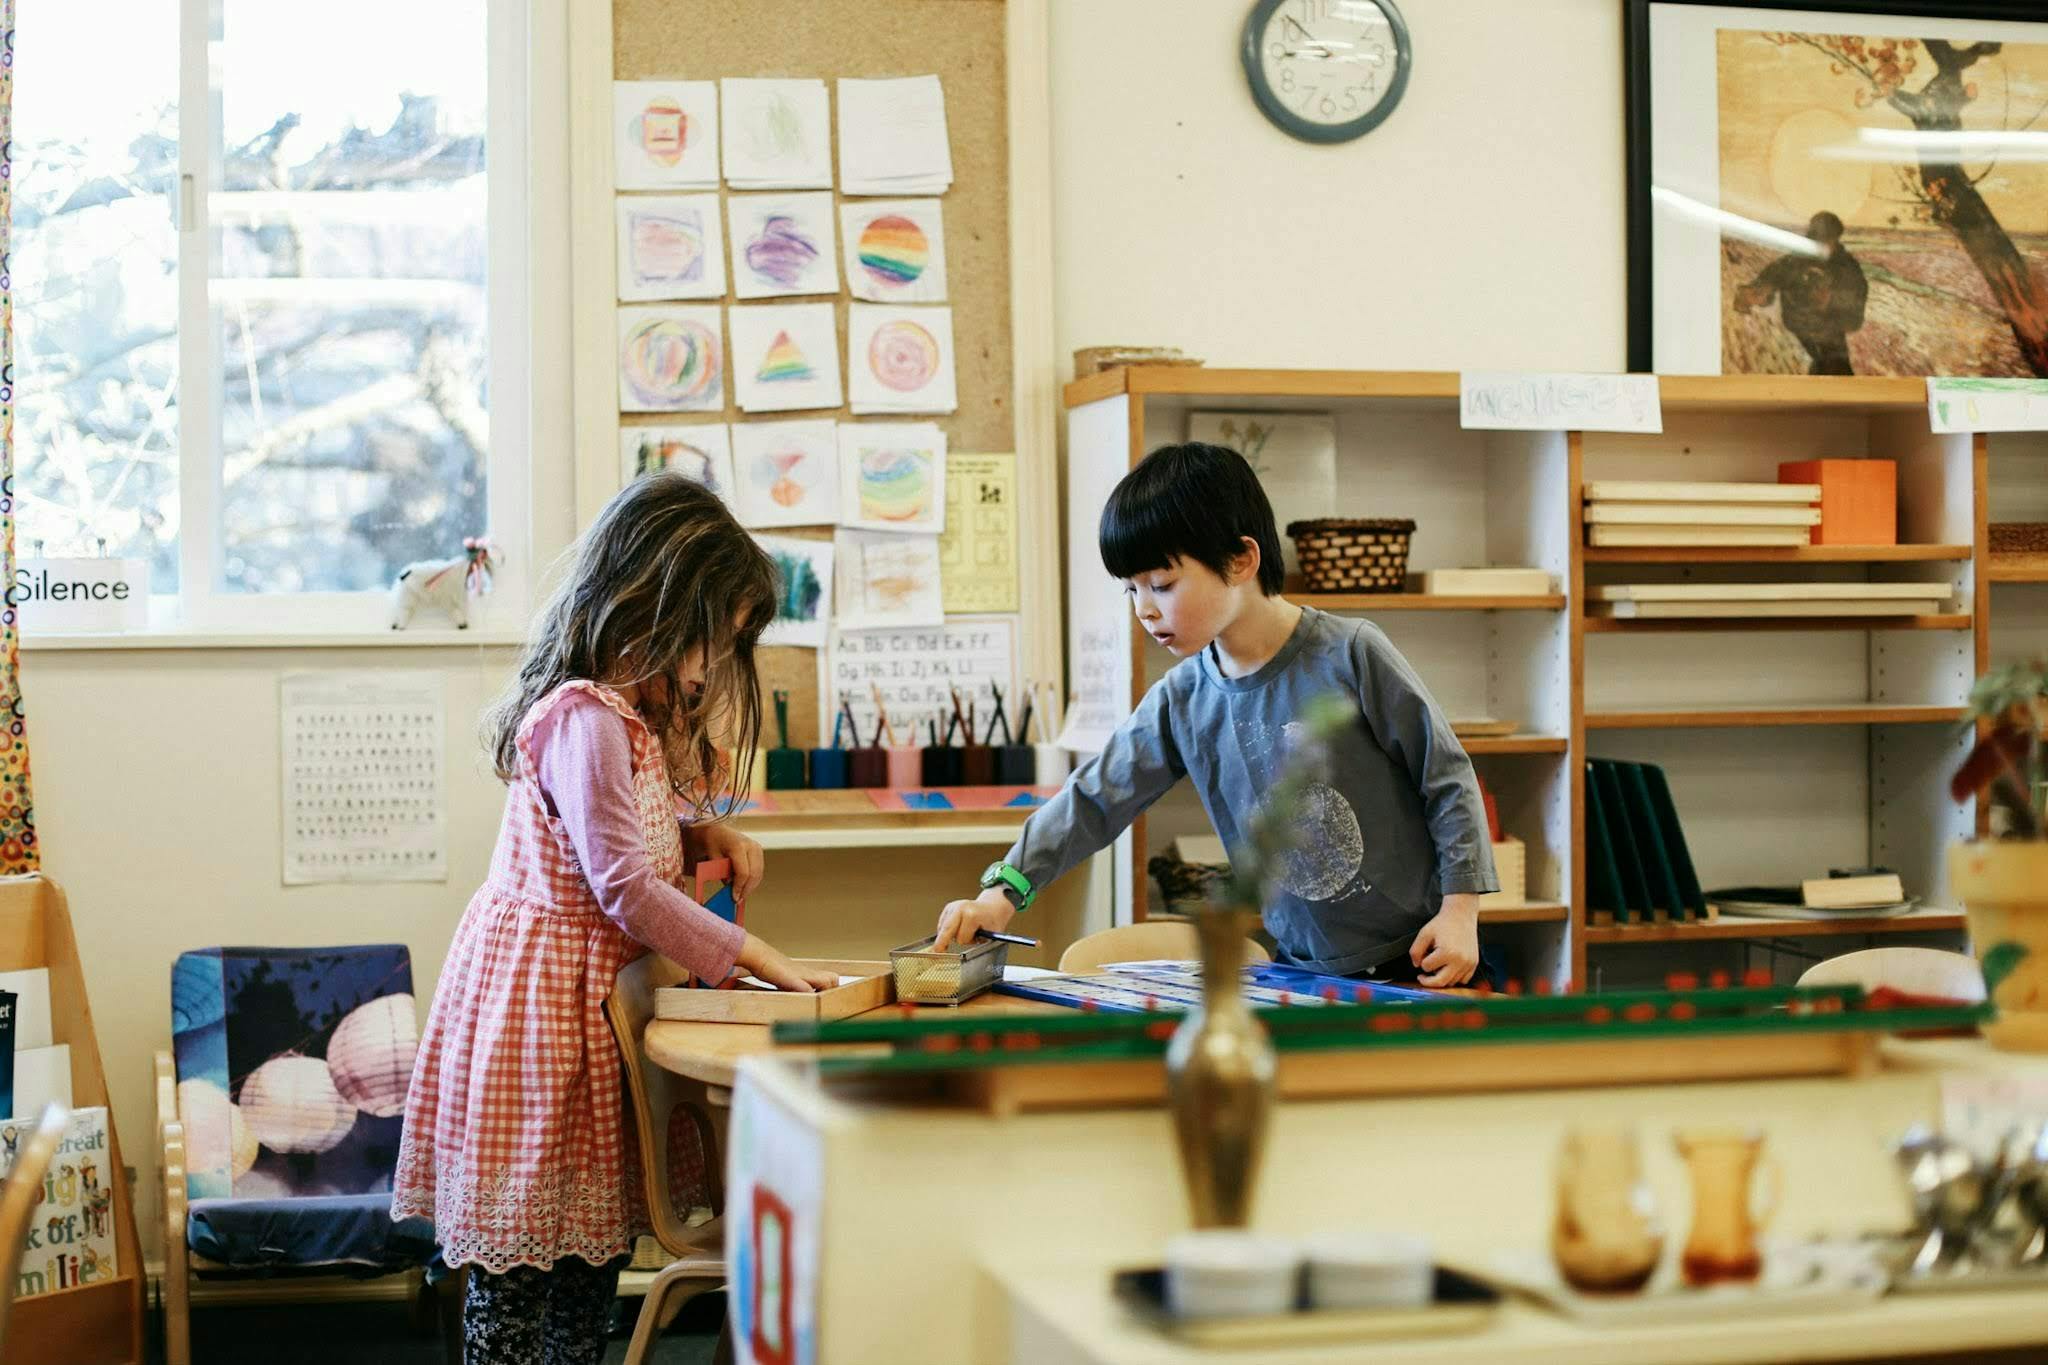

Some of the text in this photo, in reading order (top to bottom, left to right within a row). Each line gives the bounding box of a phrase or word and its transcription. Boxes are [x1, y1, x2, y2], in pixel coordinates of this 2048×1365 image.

[1281, 68, 1295, 92] 8
[1360, 71, 1375, 93] 4
[1303, 85, 1319, 110] 7
[1320, 93, 1336, 115] 6
[1341, 86, 1357, 111] 5
[16, 569, 129, 601] Silence
[864, 636, 884, 653] Bb
[917, 634, 938, 651] Dd
[970, 633, 990, 649] Ff
[911, 661, 927, 679] Jj
[17, 1254, 113, 1296] milies
